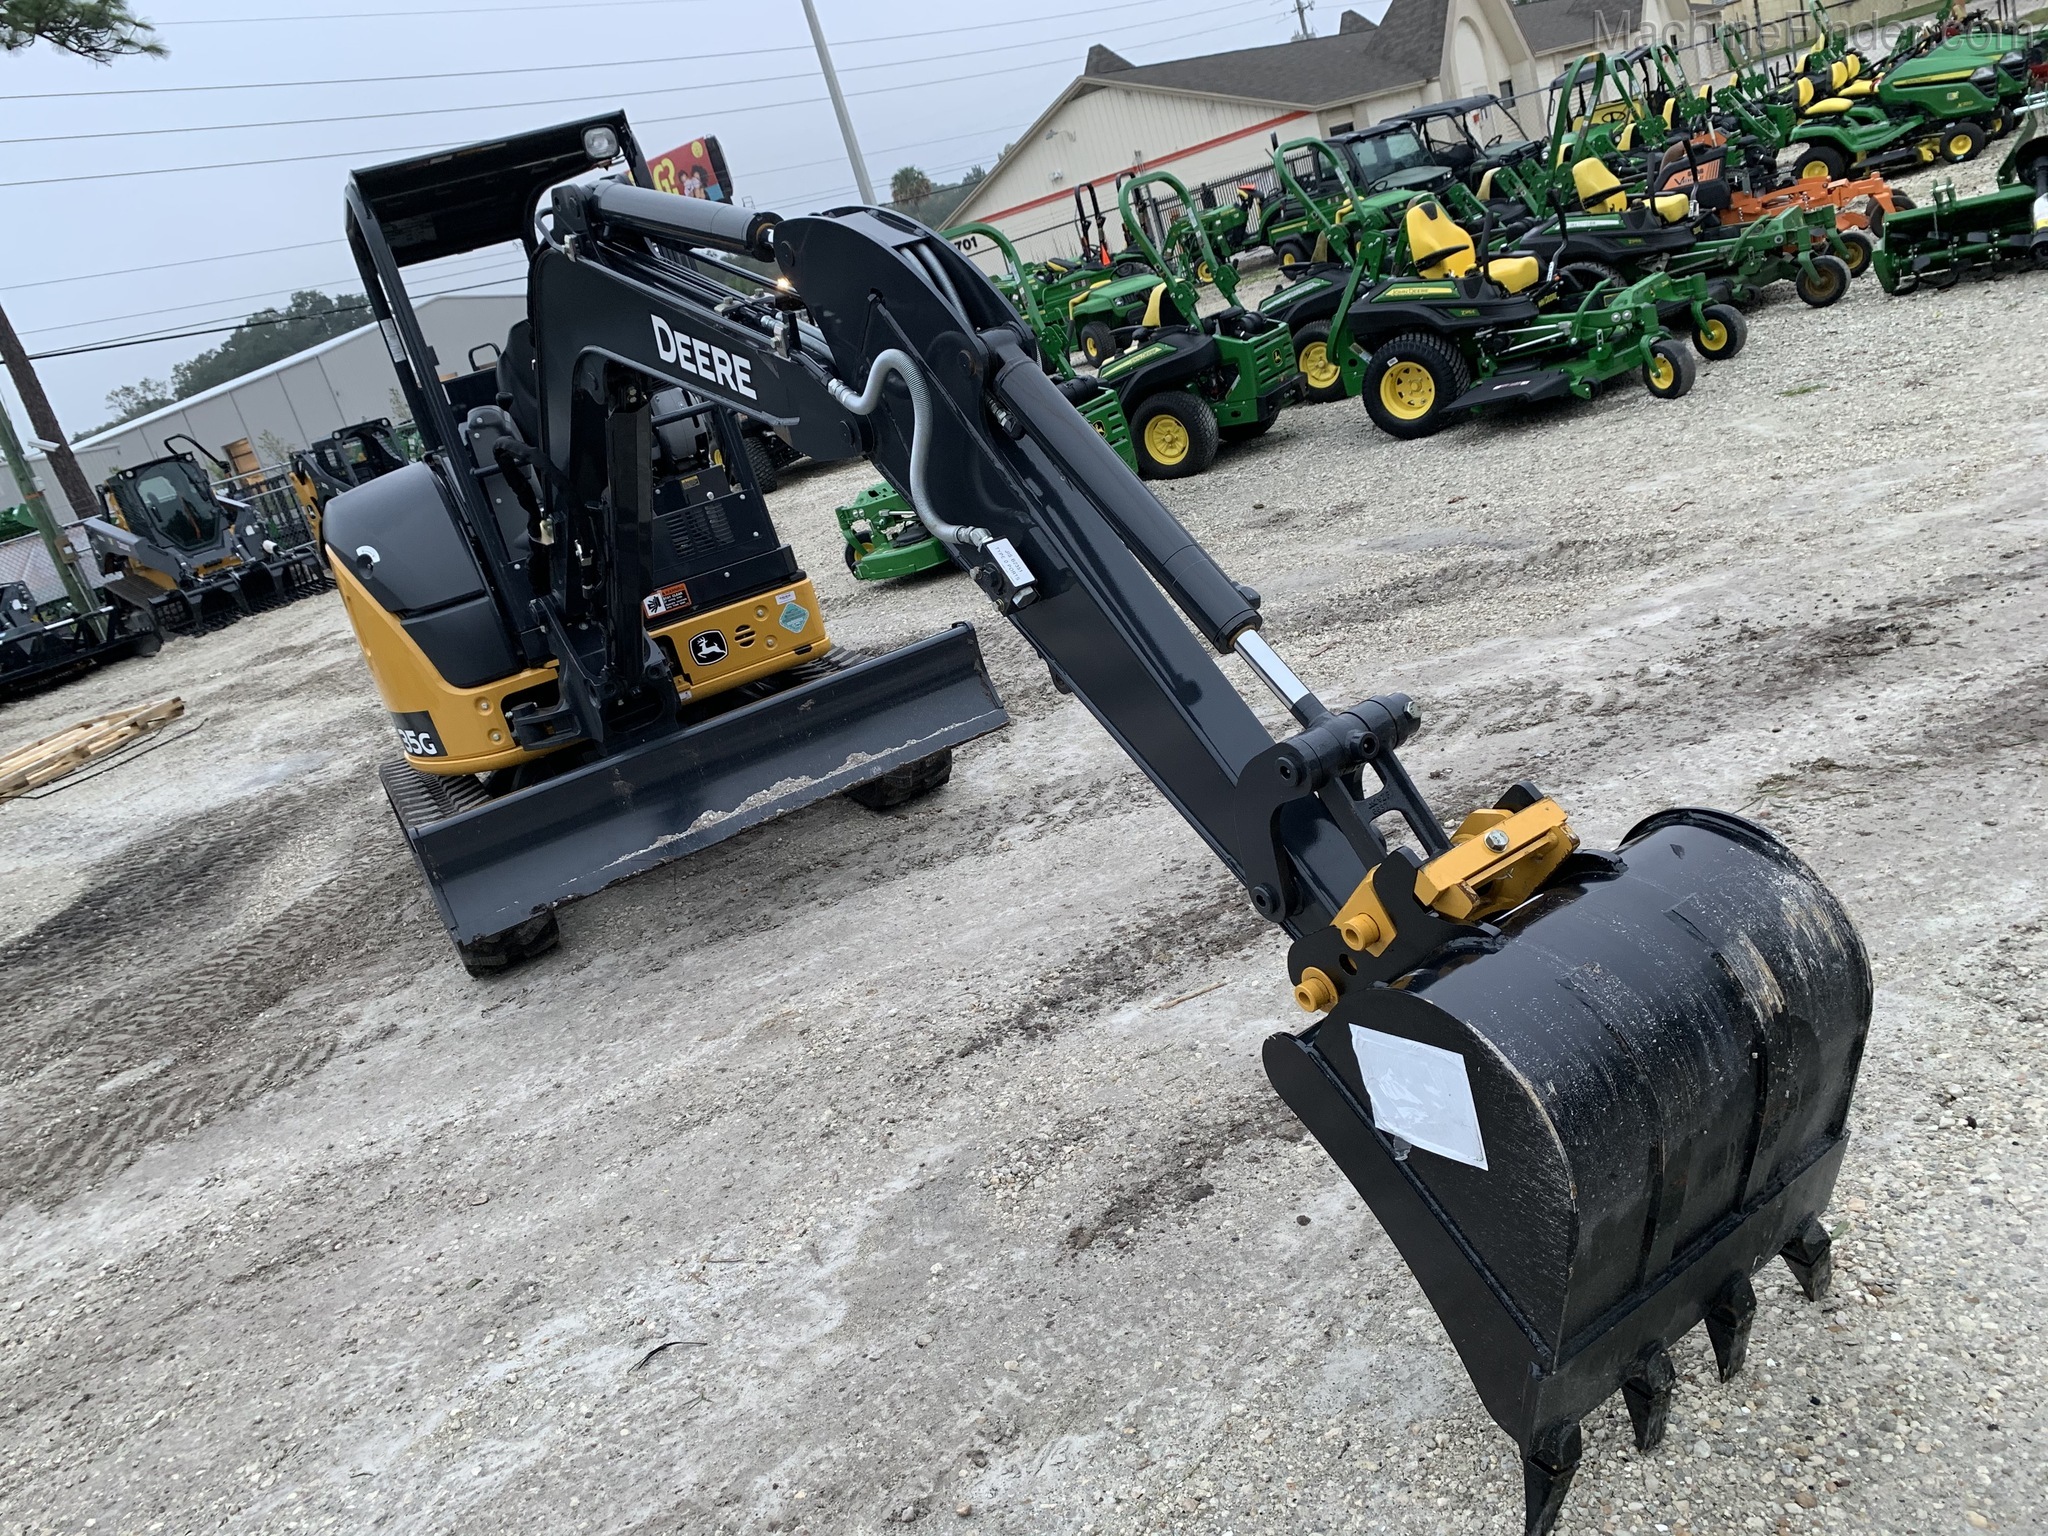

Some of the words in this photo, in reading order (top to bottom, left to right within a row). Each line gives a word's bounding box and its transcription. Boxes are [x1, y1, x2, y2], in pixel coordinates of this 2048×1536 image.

[954, 236, 978, 251] 701
[650, 314, 758, 400] DEERE
[398, 729, 437, 755] 35G
